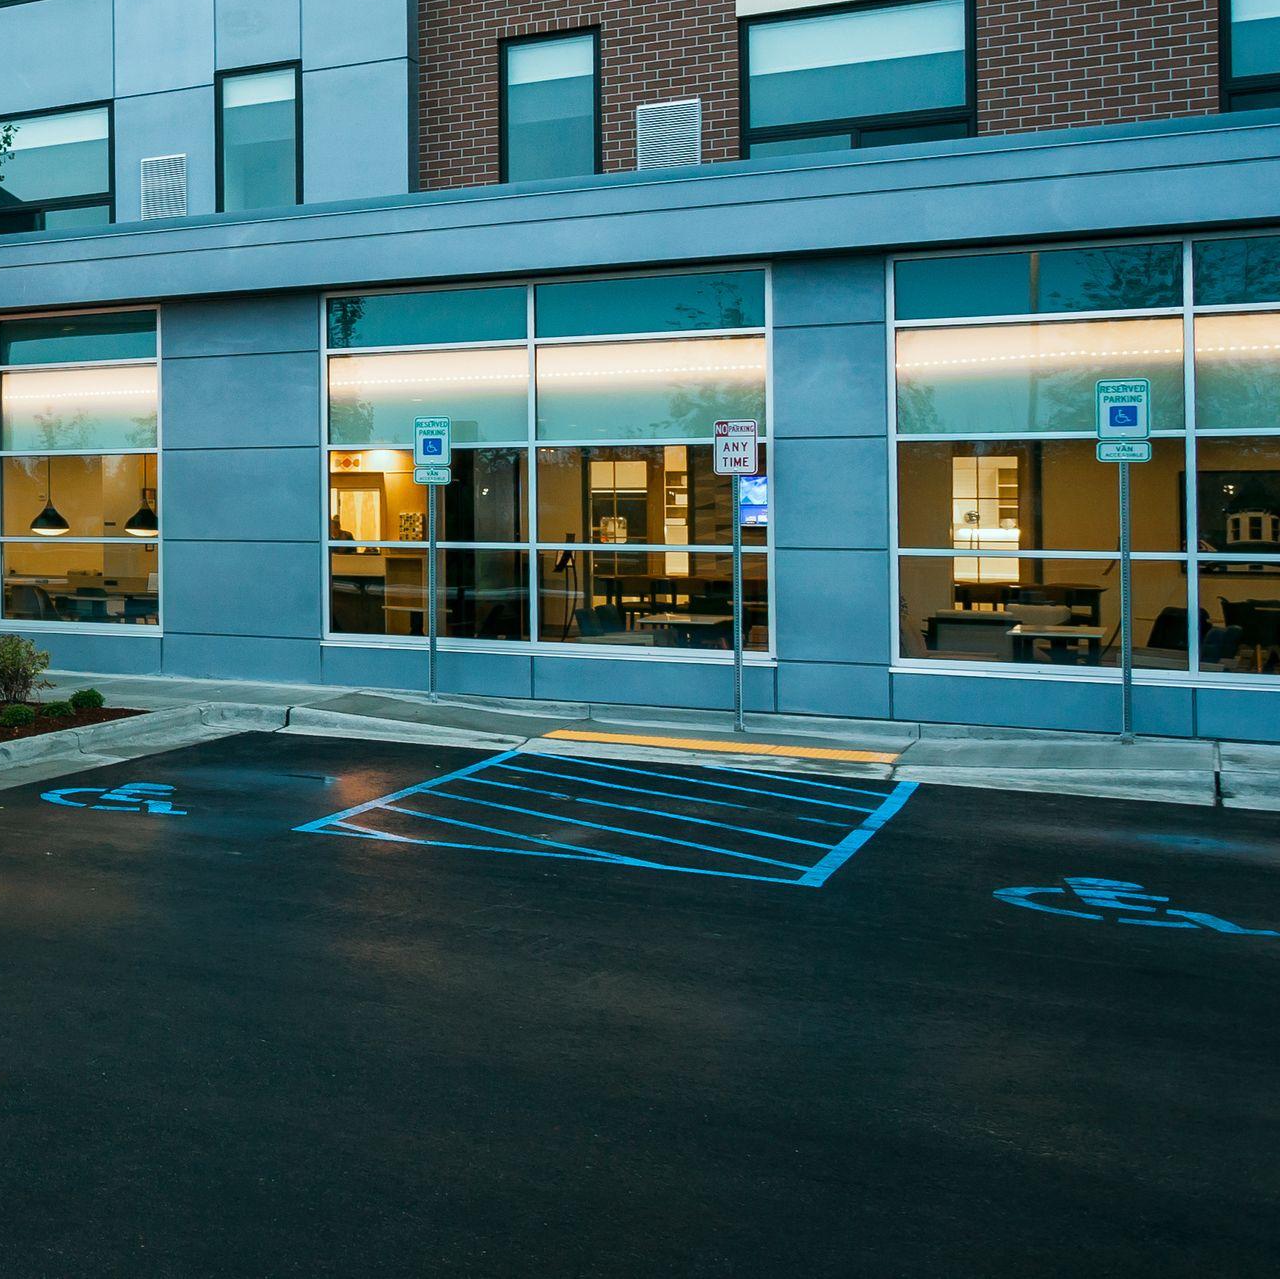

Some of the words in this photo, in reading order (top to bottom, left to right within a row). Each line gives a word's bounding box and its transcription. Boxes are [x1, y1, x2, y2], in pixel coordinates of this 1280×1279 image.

[1100, 384, 1145, 393] RESERVED
[1103, 395, 1143, 403] PARKING
[715, 423, 728, 435] NO
[728, 424, 754, 433] PARKING
[723, 442, 748, 452] ANY
[722, 457, 749, 467] TIME
